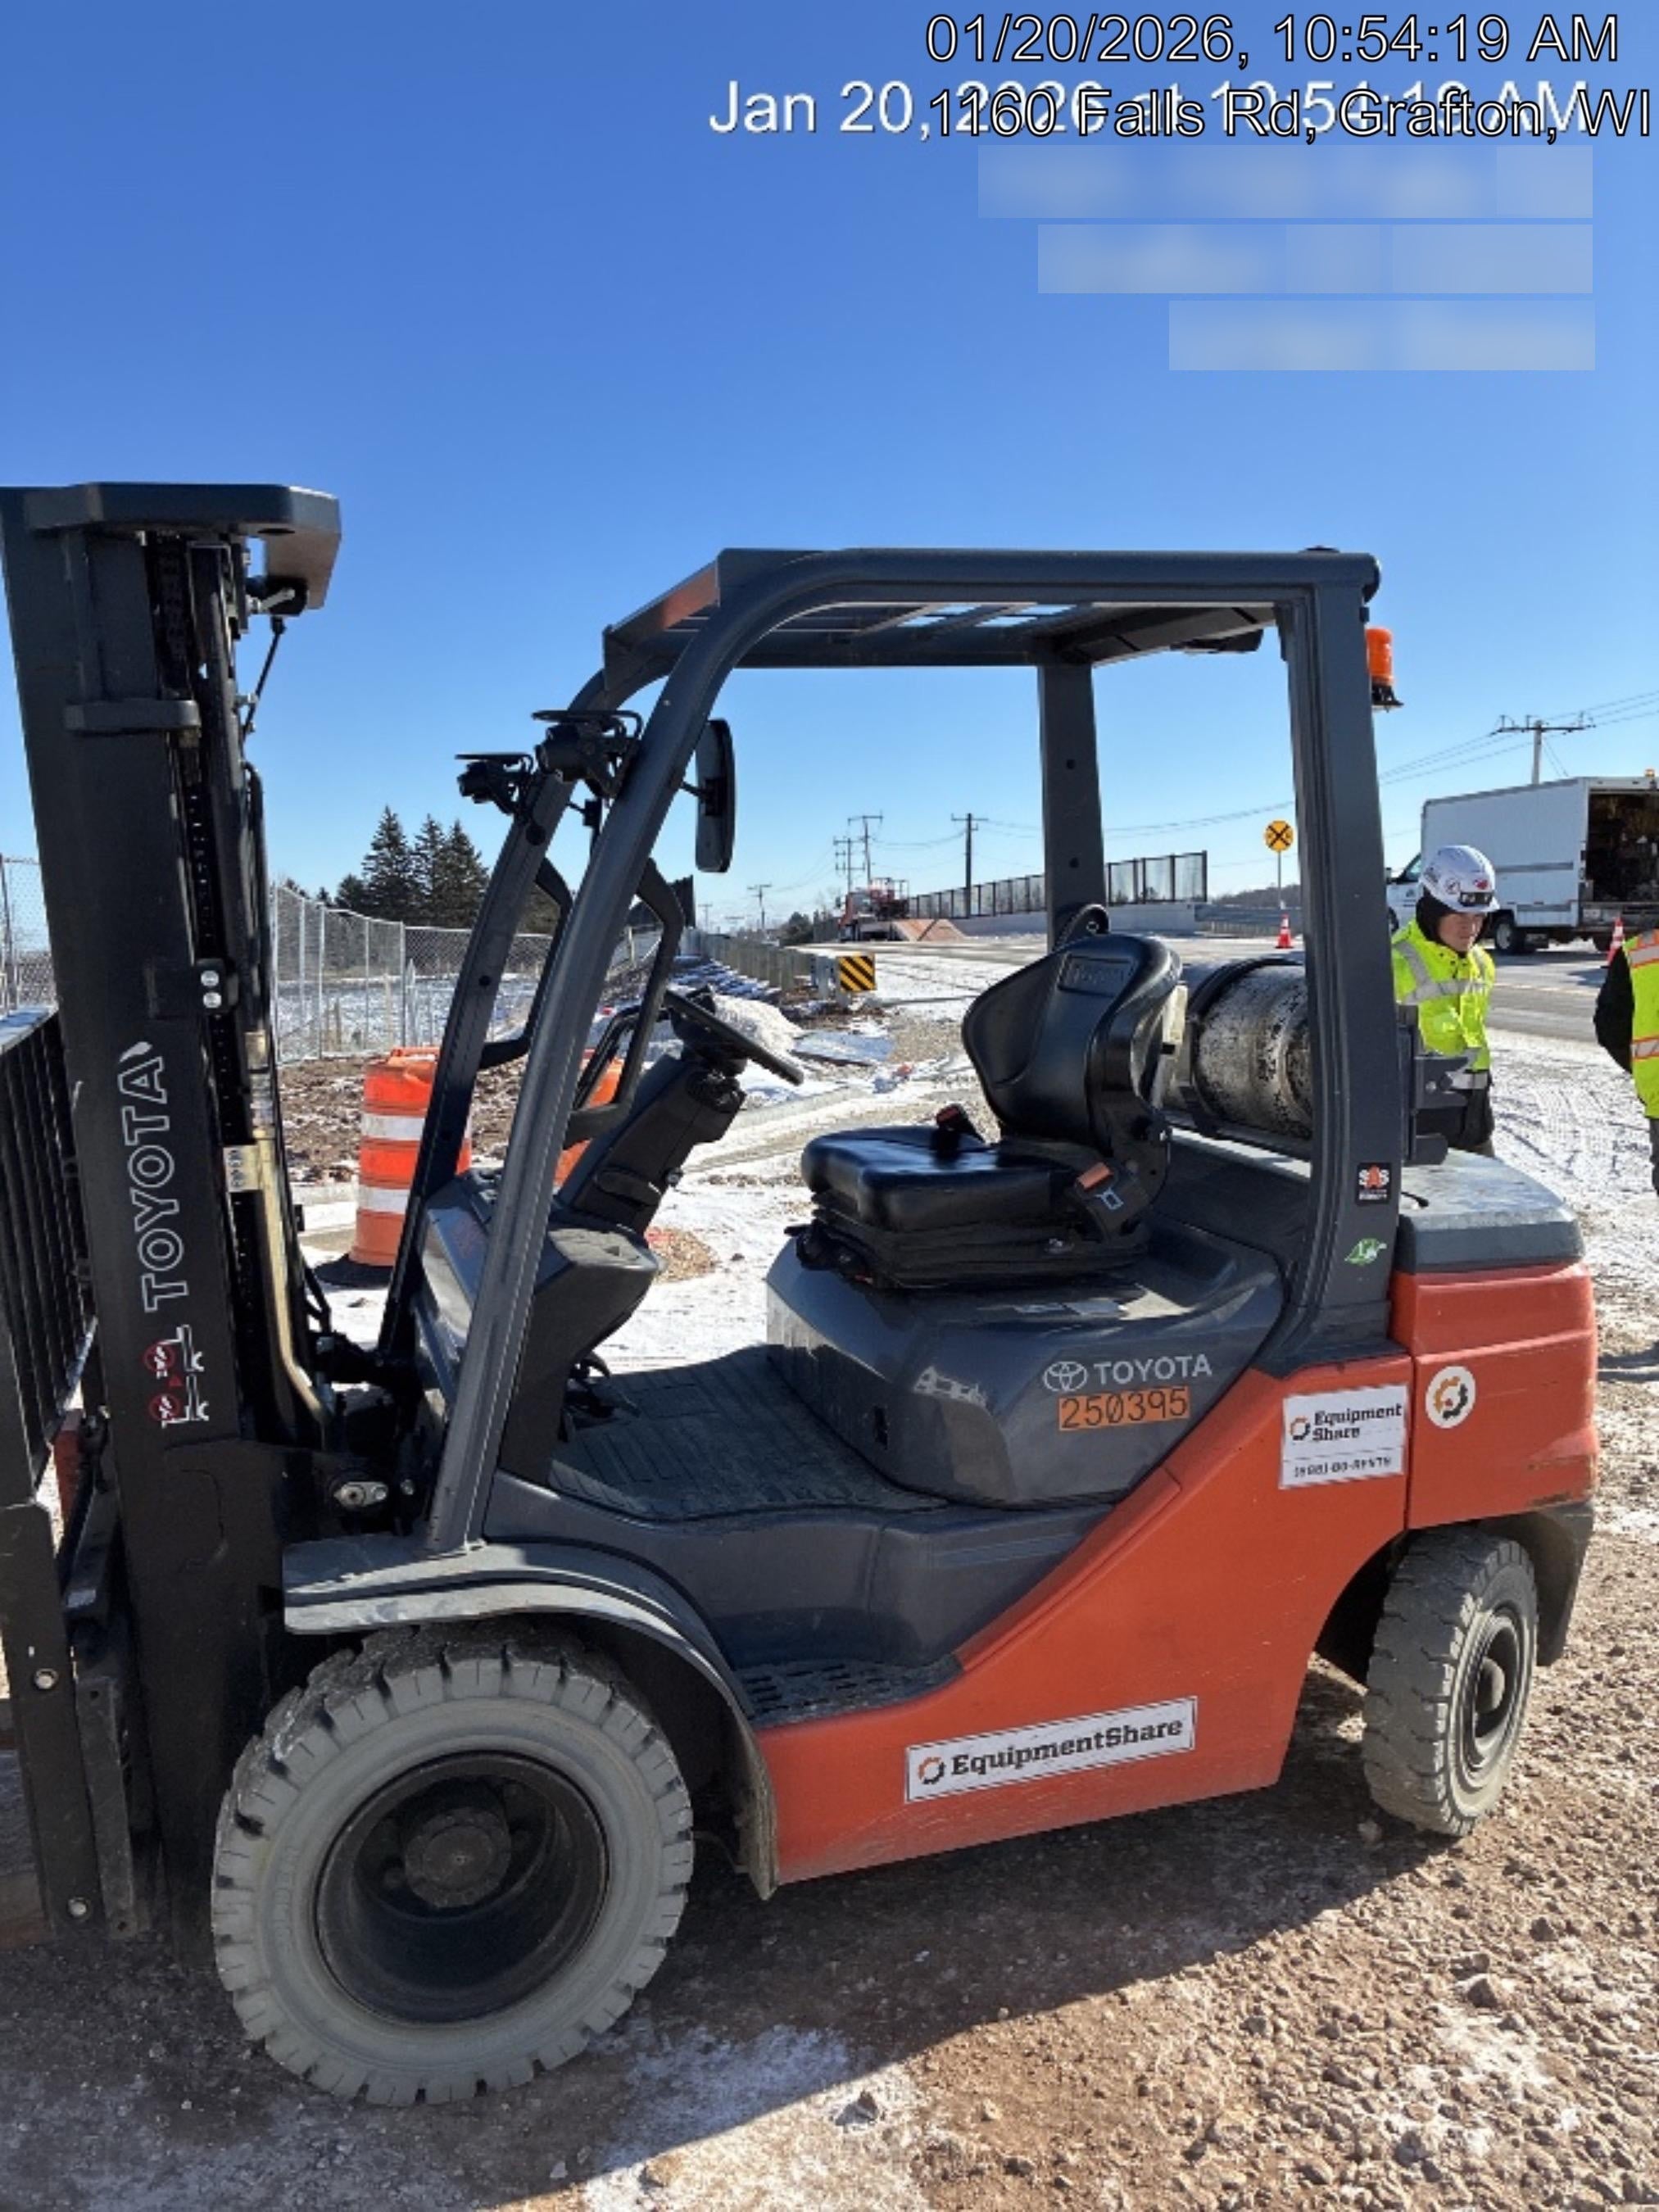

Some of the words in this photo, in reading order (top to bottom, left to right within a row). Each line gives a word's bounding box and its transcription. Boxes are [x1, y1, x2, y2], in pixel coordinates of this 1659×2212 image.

[117, 1055, 189, 1313] TOYOTA
[1093, 1353, 1213, 1385] TOYOTA
[1061, 1387, 1188, 1429] 250395
[1314, 1403, 1403, 1426] Equipment
[1312, 1427, 1361, 1442] Share
[950, 1718, 1183, 1775] EquipmentShare
